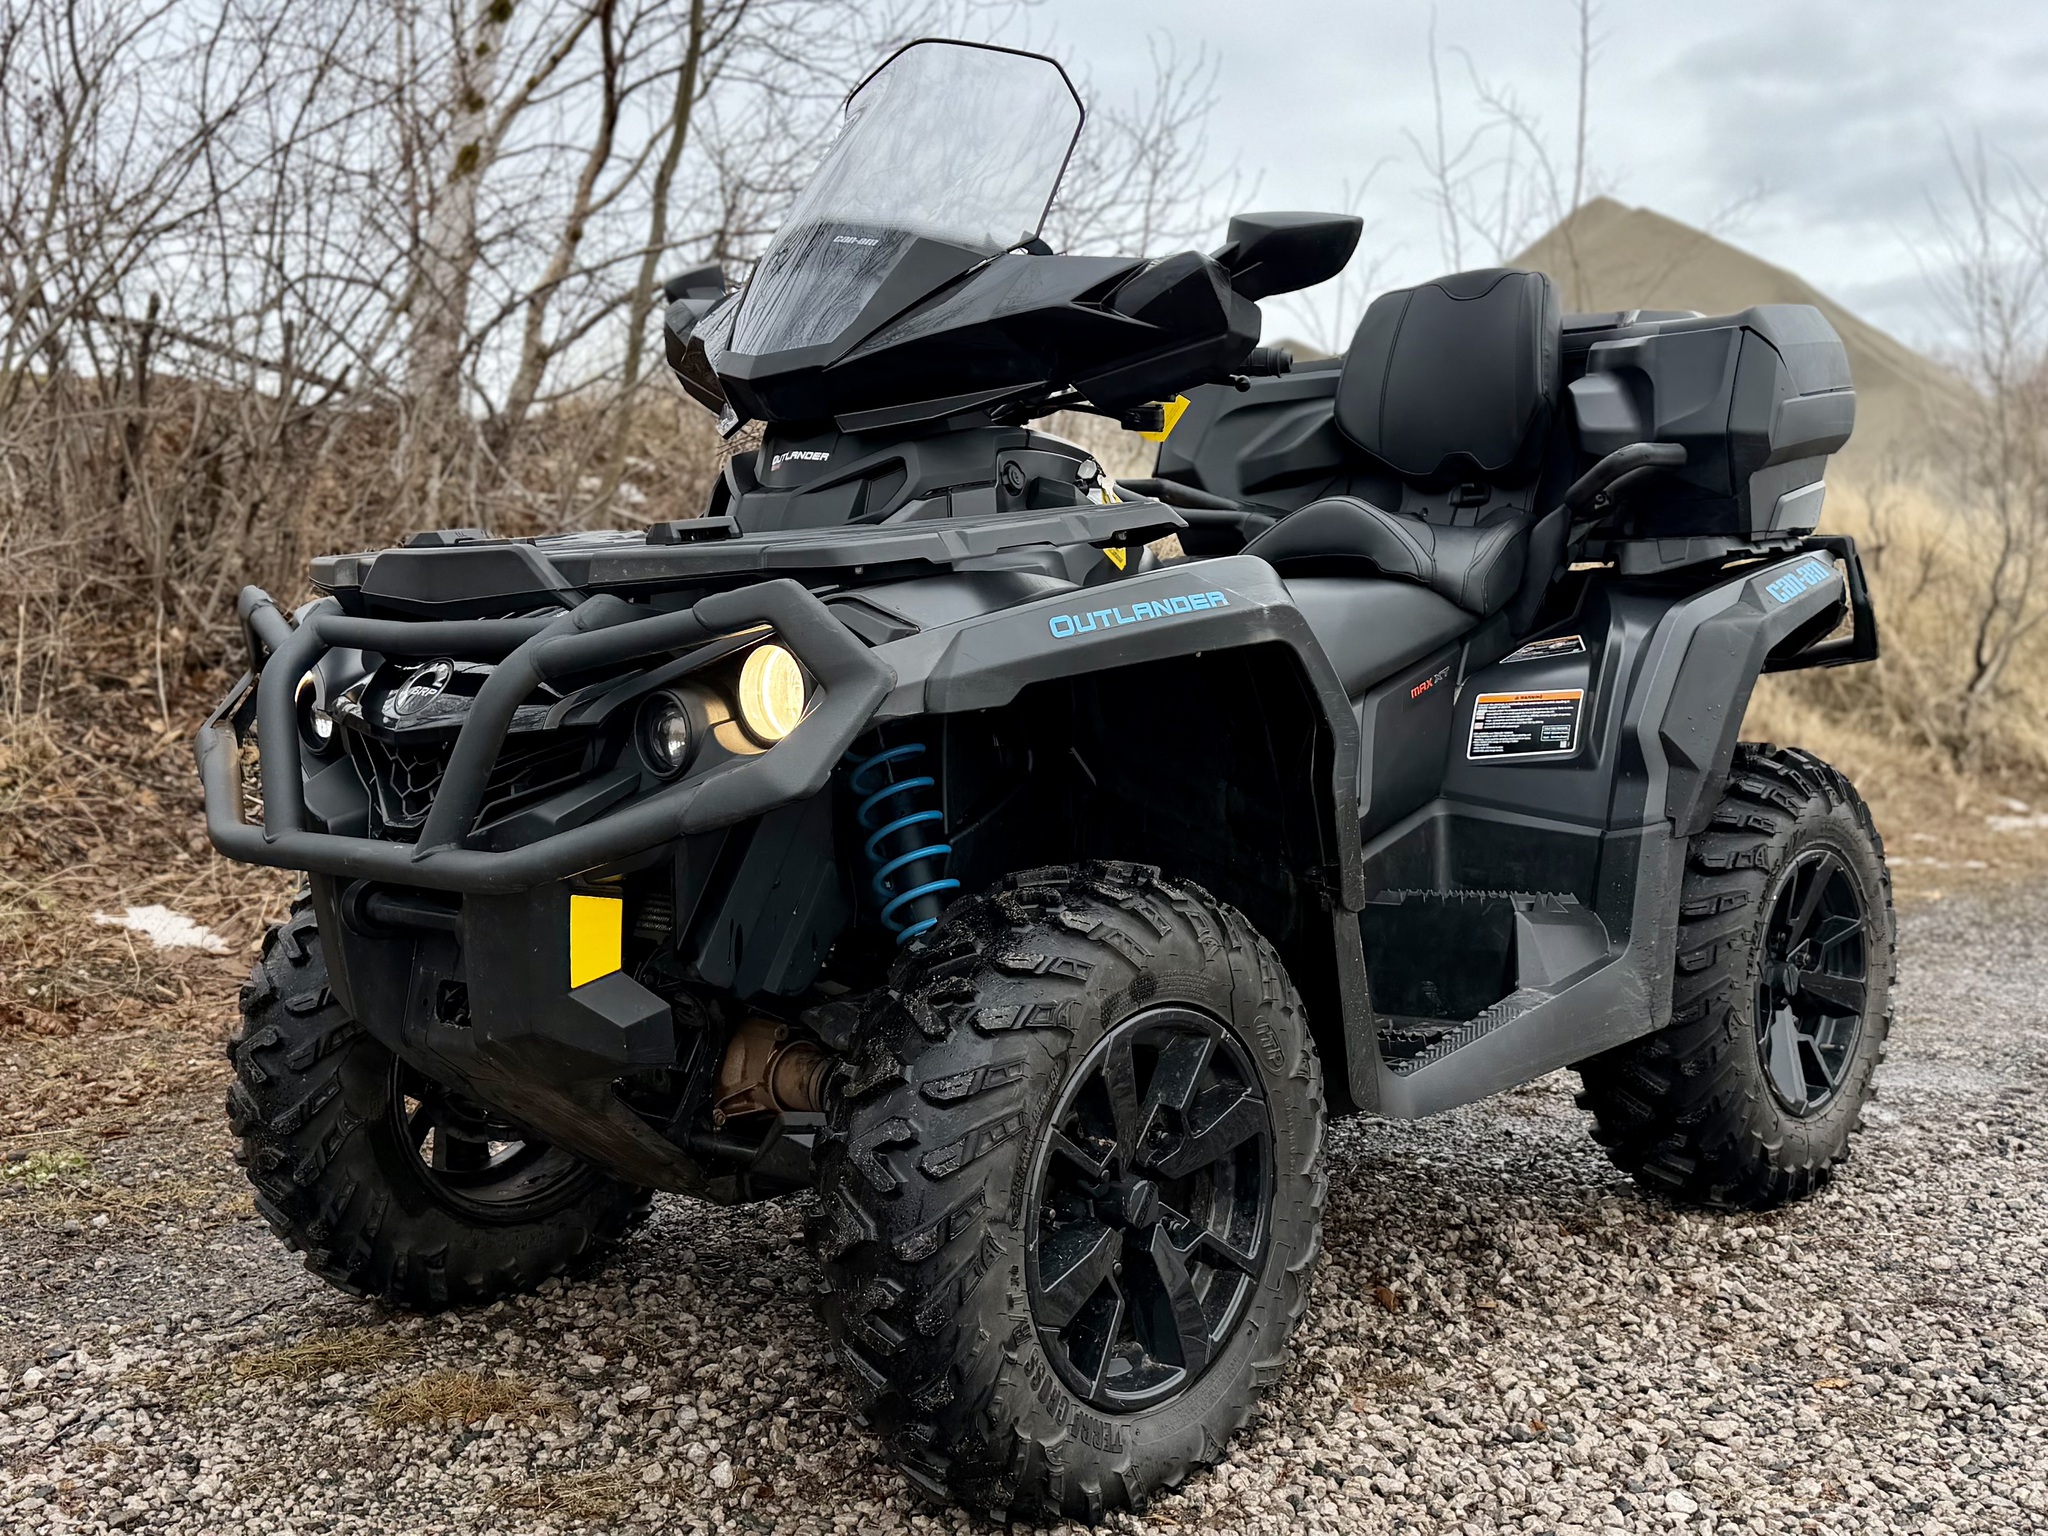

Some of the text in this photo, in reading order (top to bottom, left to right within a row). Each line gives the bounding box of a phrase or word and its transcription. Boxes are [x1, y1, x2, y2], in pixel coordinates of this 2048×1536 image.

[772, 450, 830, 466] OUTLANDER
[1765, 560, 1830, 604] can-am
[1049, 590, 1229, 639] OUTLANDER
[411, 686, 438, 697] BRP
[1410, 677, 1434, 699] MAX
